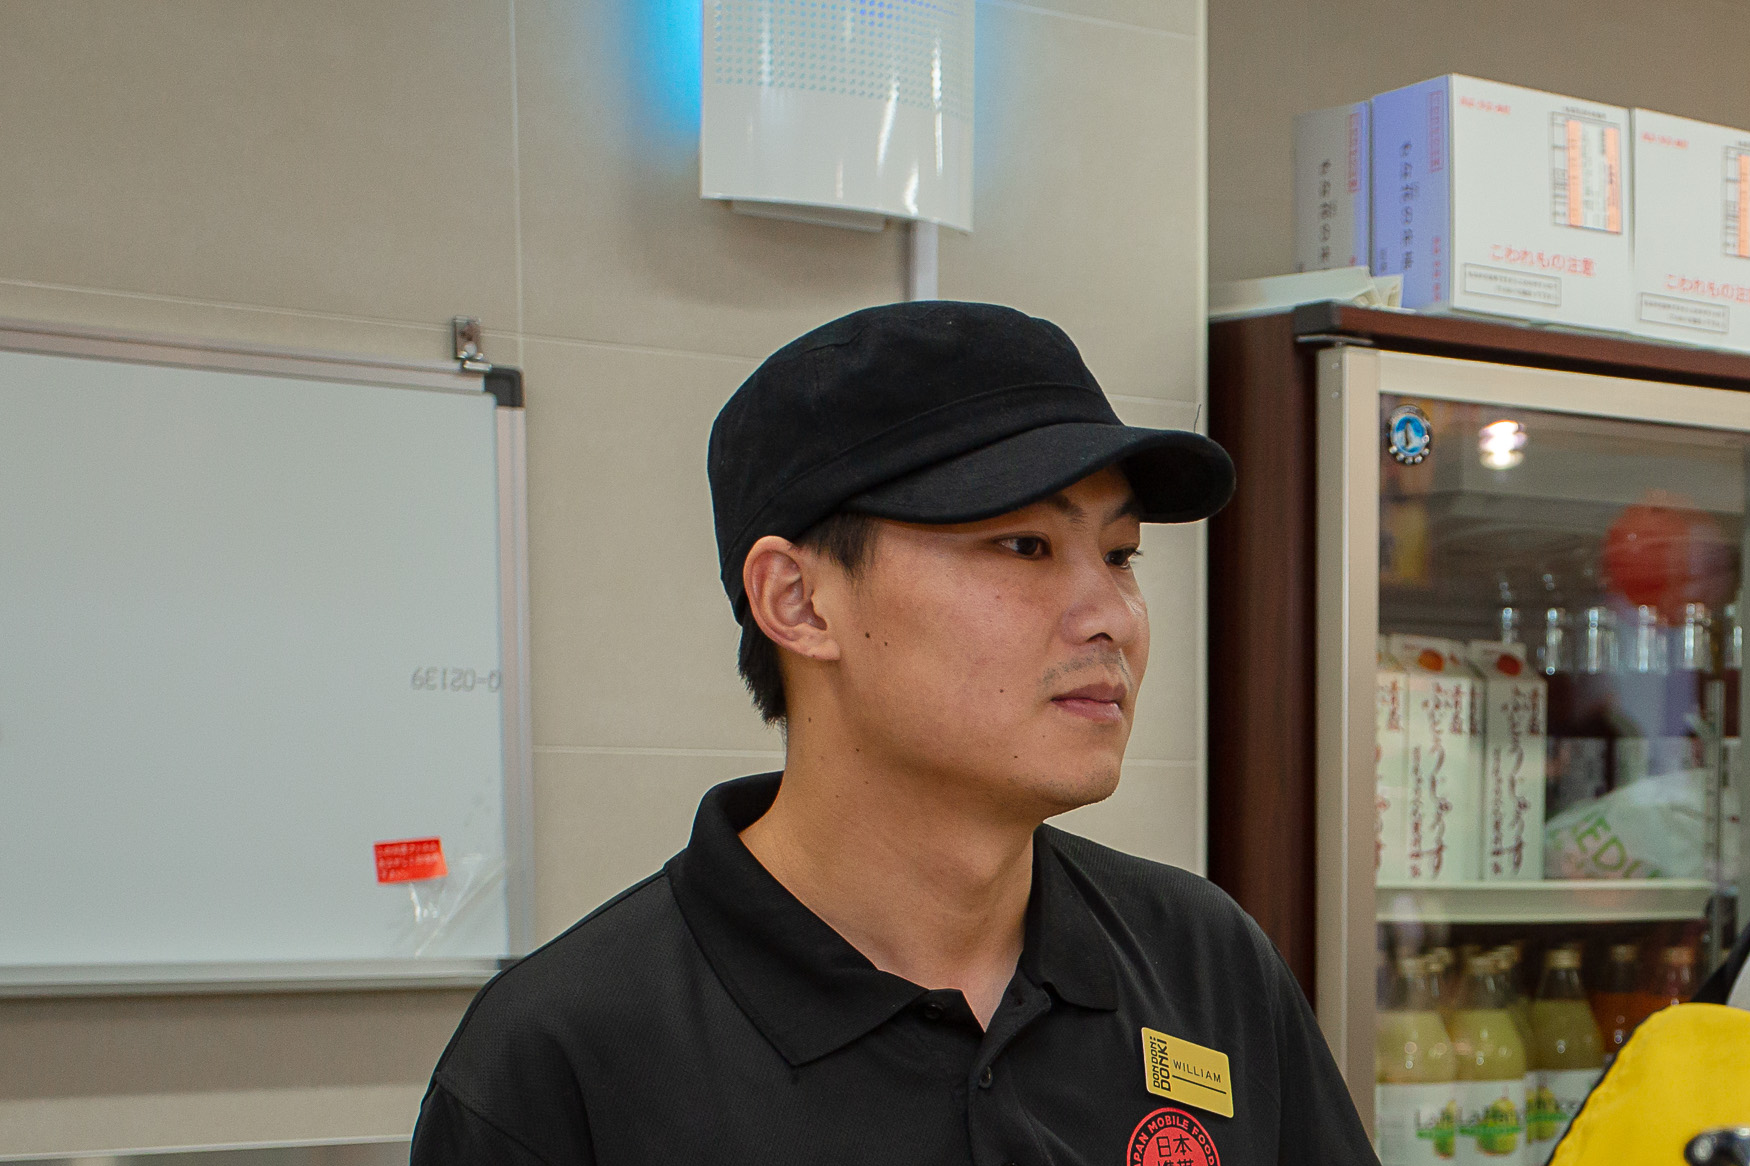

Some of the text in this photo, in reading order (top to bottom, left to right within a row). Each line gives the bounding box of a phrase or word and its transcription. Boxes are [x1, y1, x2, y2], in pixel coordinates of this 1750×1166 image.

[1490, 244, 1596, 277] こわれもの注意
[1156, 1038, 1171, 1092] DONKI
[1173, 1059, 1221, 1083] WILLIAM
[1147, 1115, 1189, 1132] MOBILE
[1155, 1134, 1192, 1158] 日本
